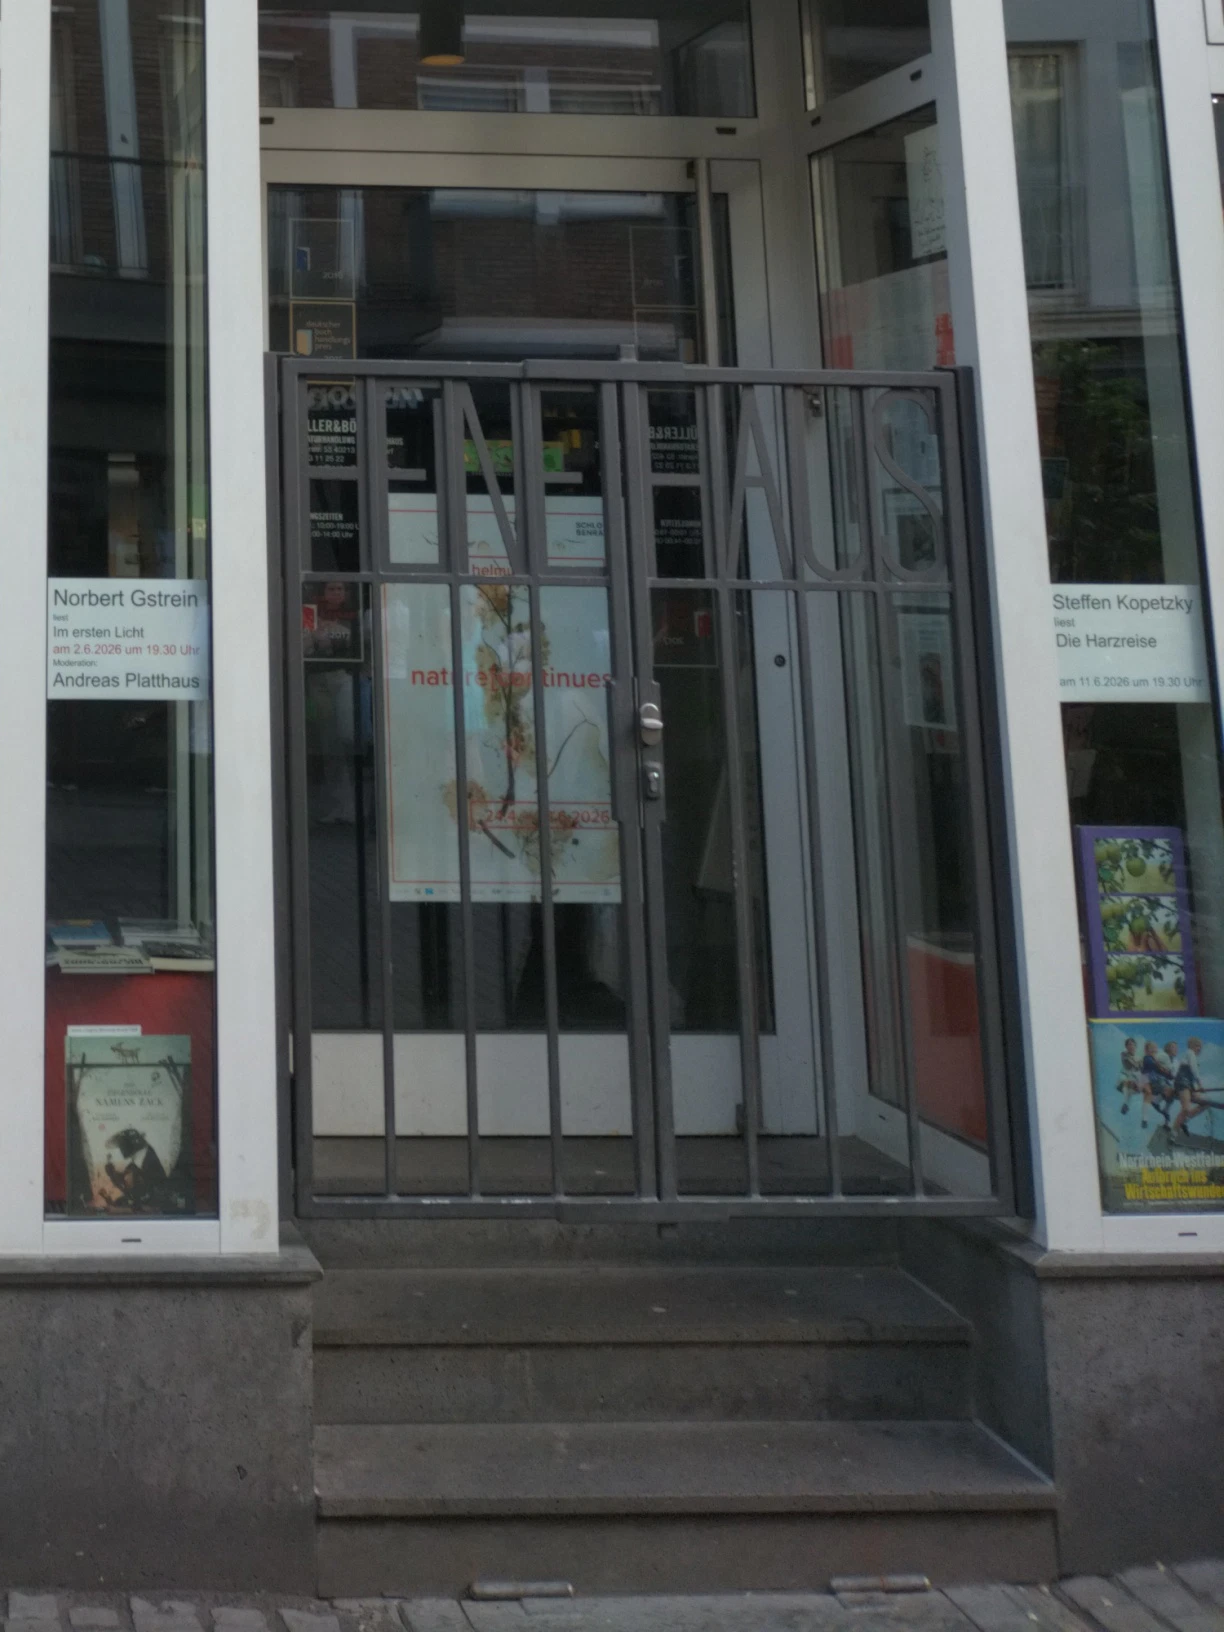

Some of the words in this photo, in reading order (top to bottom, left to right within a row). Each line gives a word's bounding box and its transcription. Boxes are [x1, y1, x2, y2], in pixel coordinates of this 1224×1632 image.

[308, 417, 357, 433] LLER&BÖ
[575, 521, 604, 529] SCHLO
[575, 529, 605, 537] BENRA
[53, 589, 124, 607] Norbert
[130, 589, 198, 607] Gstrein
[1052, 593, 1112, 610] Steffen
[1117, 594, 1194, 615] Kopetzky
[1054, 617, 1076, 627] liest
[53, 626, 68, 638] Im
[72, 627, 111, 638] ersten
[114, 626, 144, 639] Licht
[1056, 633, 1081, 648] Die
[1086, 633, 1158, 648] Harzreise
[52, 645, 70, 654] am
[73, 644, 122, 655] 2.6.2026
[126, 645, 142, 655] um
[146, 644, 177, 655] 19.30
[180, 645, 200, 656] Uhr
[52, 658, 98, 667] Moderation:
[52, 672, 120, 688] Andreas
[125, 672, 200, 688] Platthaus
[1059, 677, 1076, 687] am
[1079, 676, 1130, 687] 11.6.2026
[1133, 678, 1149, 687] um
[1153, 676, 1181, 687] 19.30
[1118, 1150, 1224, 1169] Nordrhein-Westfale
[1123, 1182, 1224, 1200] Wirtschaftswunde
